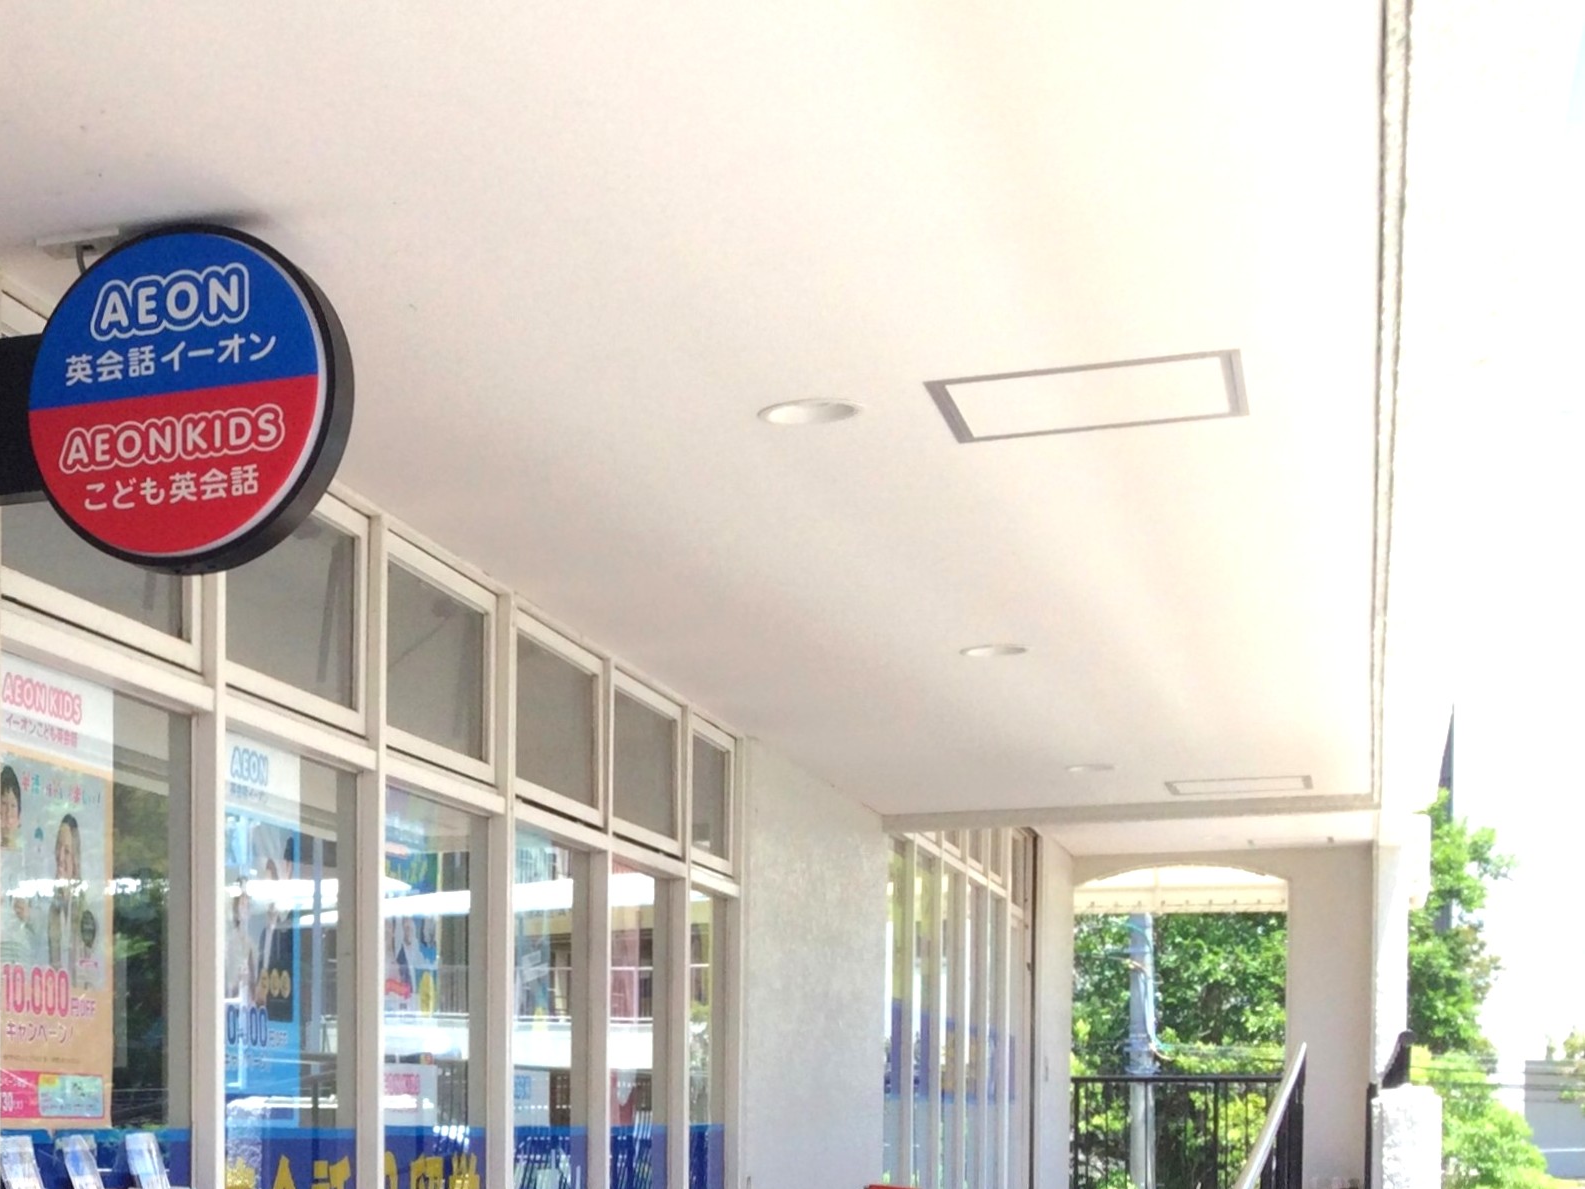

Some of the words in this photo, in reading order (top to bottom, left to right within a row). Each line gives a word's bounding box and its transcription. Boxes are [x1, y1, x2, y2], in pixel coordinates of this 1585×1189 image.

[91, 264, 249, 340] AEON
[65, 334, 276, 387] 英会話イーオン
[84, 464, 259, 512] こども英会話
[230, 746, 269, 788] AEON
